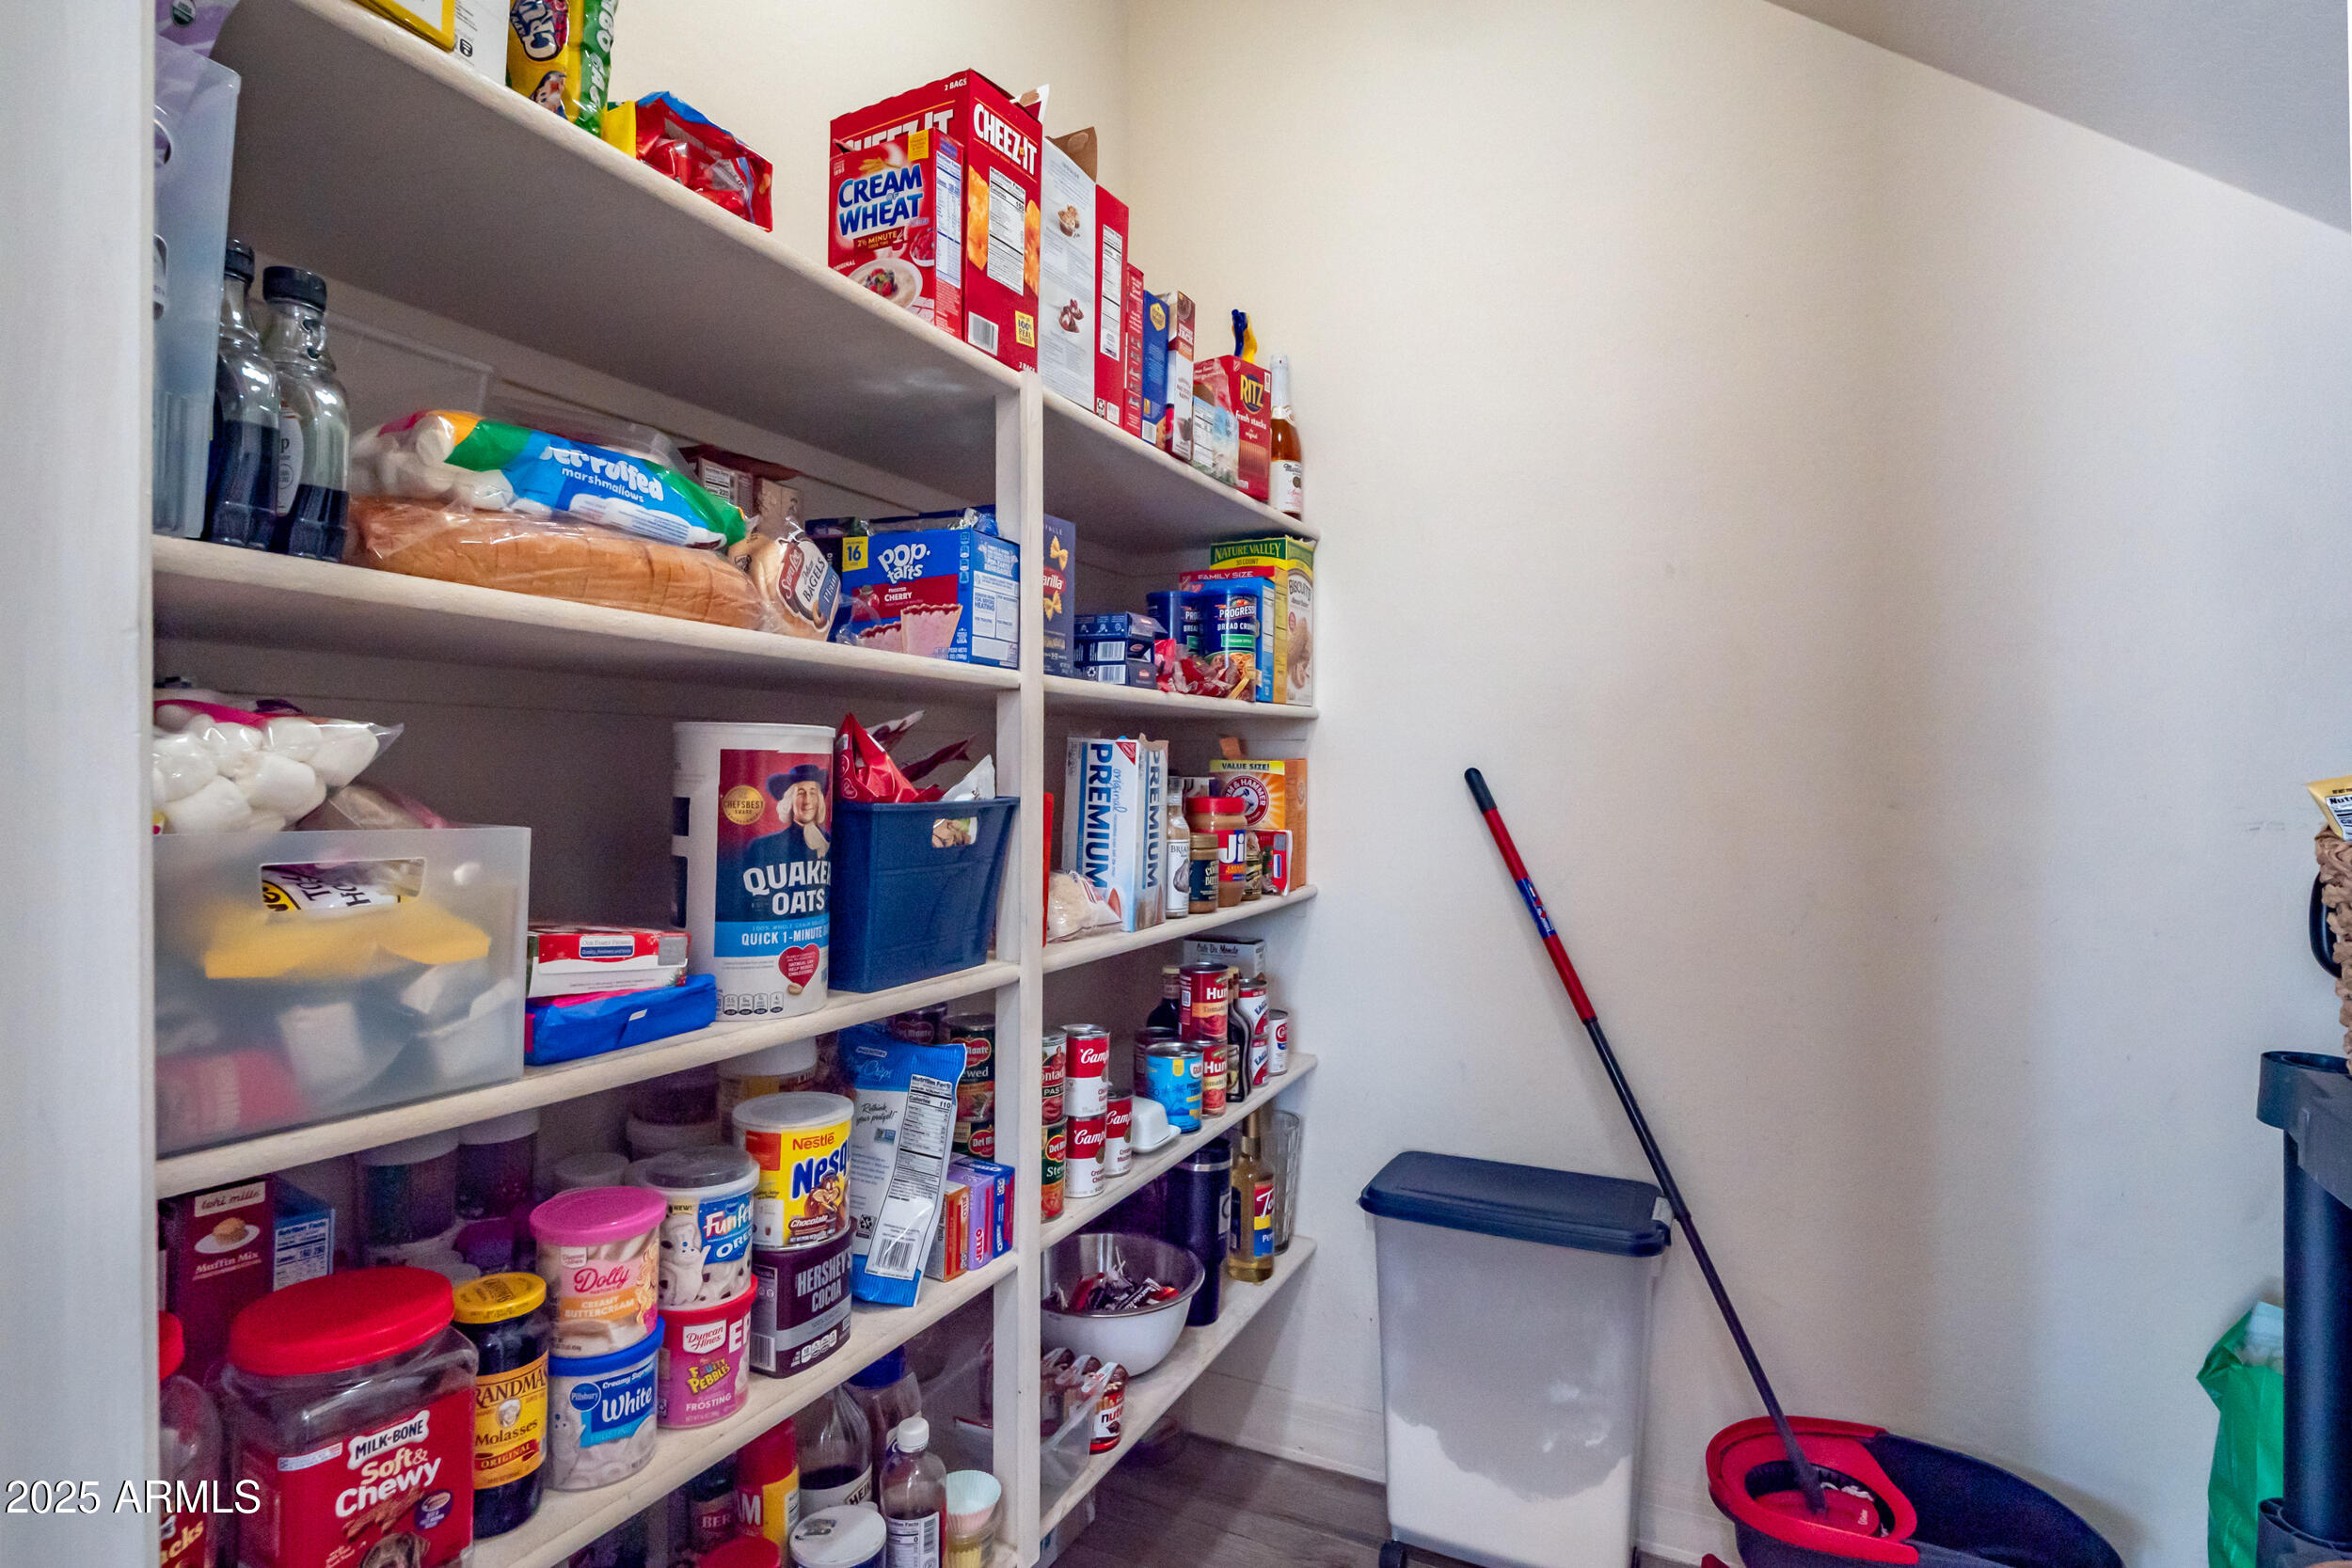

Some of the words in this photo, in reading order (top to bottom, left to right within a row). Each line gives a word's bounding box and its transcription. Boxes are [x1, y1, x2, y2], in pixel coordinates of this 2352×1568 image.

[949, 78, 967, 90] BAGS
[838, 164, 923, 208] CREAM
[838, 193, 923, 236] WHEAT
[868, 230, 898, 244] MINUTE
[1240, 374, 1264, 407] RITZ
[1235, 410, 1250, 423] fresh
[1250, 417, 1267, 430] stacks
[562, 467, 644, 503] marshmallows
[847, 545, 862, 562] 16
[1215, 545, 1248, 562] NATURE
[1248, 542, 1281, 558] VALLEY
[803, 557, 826, 602] BAGELS
[887, 564, 923, 584] tarts
[1042, 573, 1063, 591] arilla
[1198, 572, 1231, 580] FAMILY
[1232, 570, 1254, 578] SIZE
[823, 575, 837, 603] Plain
[884, 592, 913, 602] CHERRY
[1217, 622, 1238, 631] BREAD
[1112, 768, 1128, 814] original
[1240, 777, 1266, 807] HAMMER
[723, 800, 764, 810] CHEFSBEST
[1085, 743, 1113, 889] PREMIUM
[1147, 750, 1161, 888] PREMIUM
[771, 888, 825, 916] OATS
[741, 932, 779, 946] QUICK
[783, 926, 822, 943] 1-MINUTE
[912, 1075, 935, 1086] Nutrition
[909, 1095, 930, 1104] Calories
[790, 1214, 829, 1227] Chocolate
[195, 1257, 236, 1275] Muffin
[237, 1251, 259, 1262] Mix
[573, 1265, 629, 1293] Dolly
[581, 1295, 619, 1309] CREAMY
[811, 1278, 842, 1313] COCOA
[564, 1298, 635, 1318] BUTTERCREAM
[686, 1325, 723, 1343] Duncan
[691, 1336, 722, 1351] Hines
[602, 1375, 631, 1389] Creamy
[688, 1363, 731, 1394] PEBBLES
[571, 1391, 599, 1402] Pillsbury
[602, 1386, 652, 1423] White
[686, 1392, 732, 1412] FROSTING
[355, 1419, 423, 1460] MILK-BONE
[474, 1418, 538, 1447] Molasses
[360, 1447, 413, 1485] Soft
[412, 1448, 428, 1465] &
[480, 1444, 532, 1469] ORIGINAL
[335, 1457, 442, 1518] Chewy
